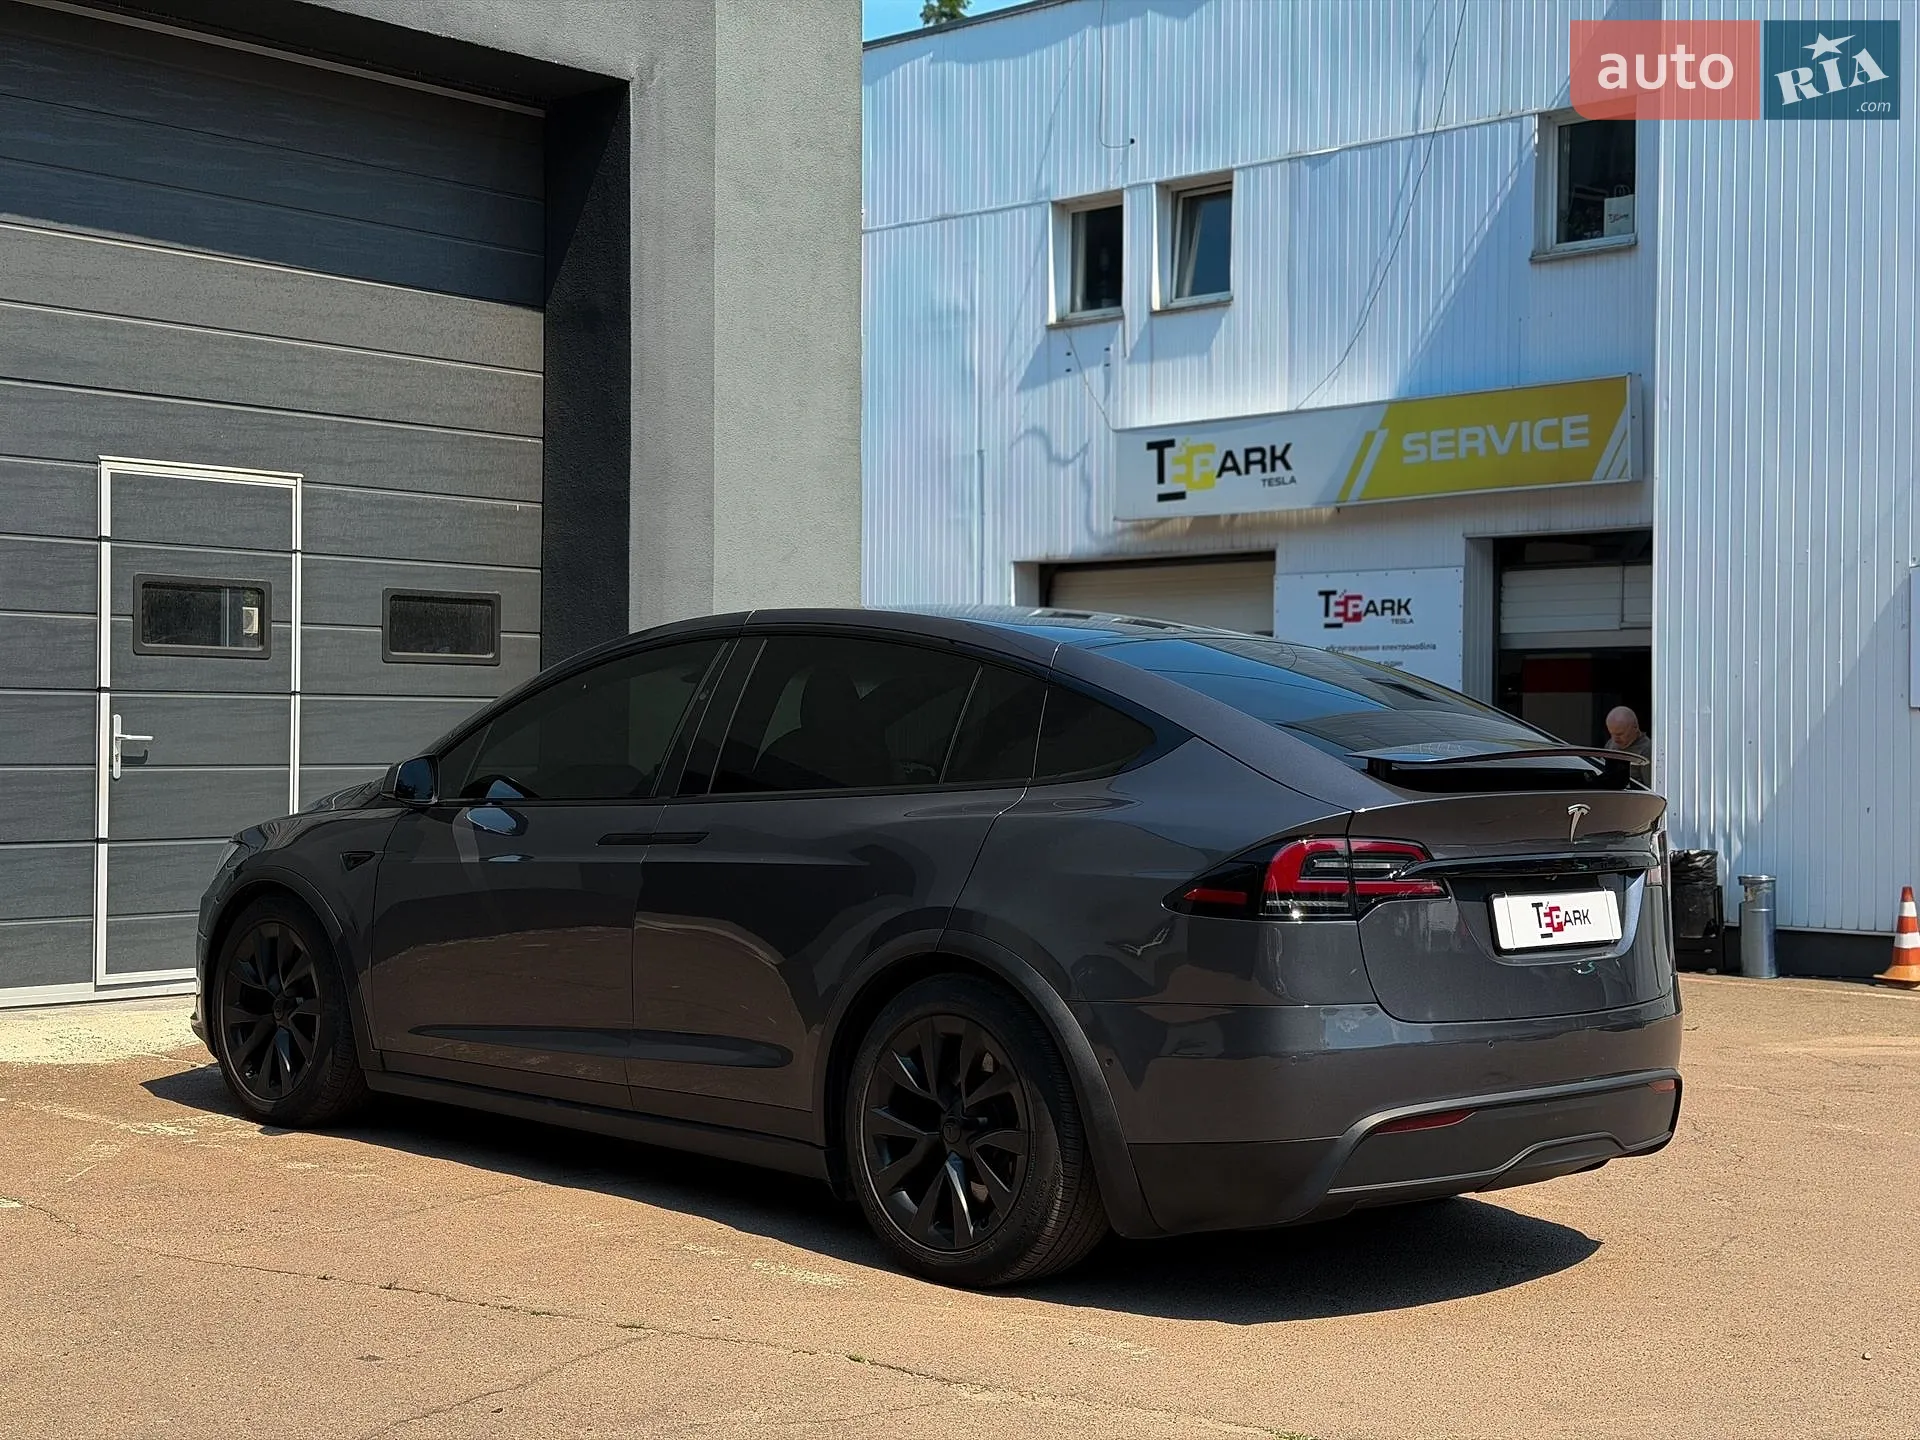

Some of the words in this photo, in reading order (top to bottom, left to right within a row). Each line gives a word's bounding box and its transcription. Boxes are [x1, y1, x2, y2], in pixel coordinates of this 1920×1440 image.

[1402, 414, 1590, 464] SERVICE
[1261, 475, 1297, 488] TESLA
[1391, 617, 1415, 625] TESLA
